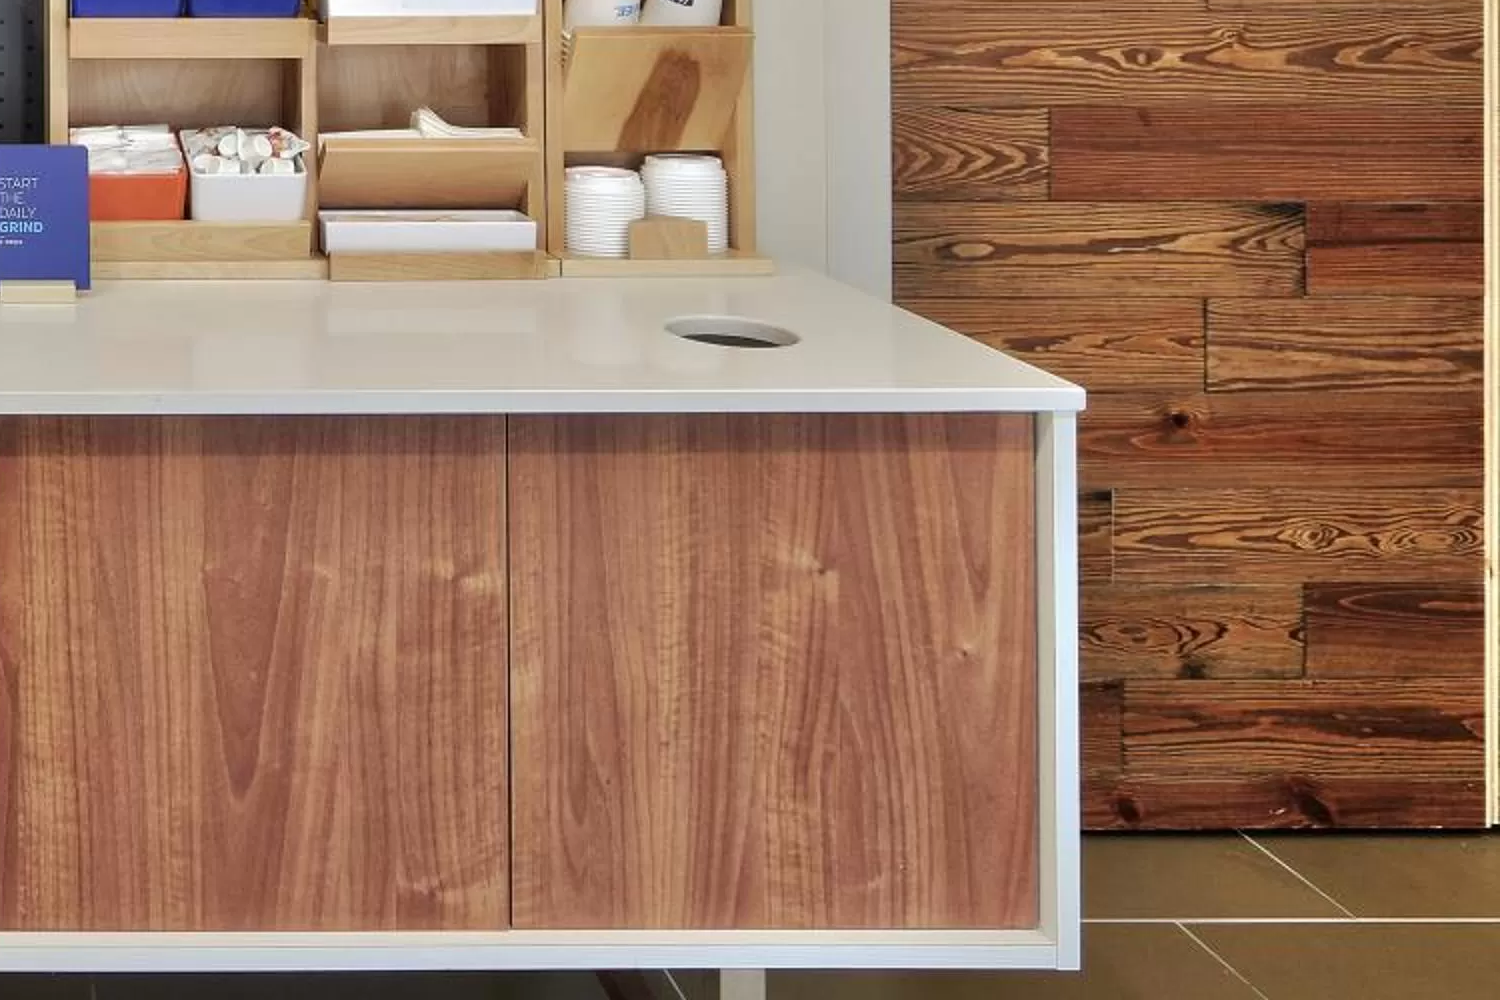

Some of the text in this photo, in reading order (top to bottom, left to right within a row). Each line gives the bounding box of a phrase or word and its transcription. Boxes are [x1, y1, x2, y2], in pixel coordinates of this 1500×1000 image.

[0, 177, 38, 190] START
[0, 207, 37, 219] DAILY
[0, 221, 43, 232] GRIND
